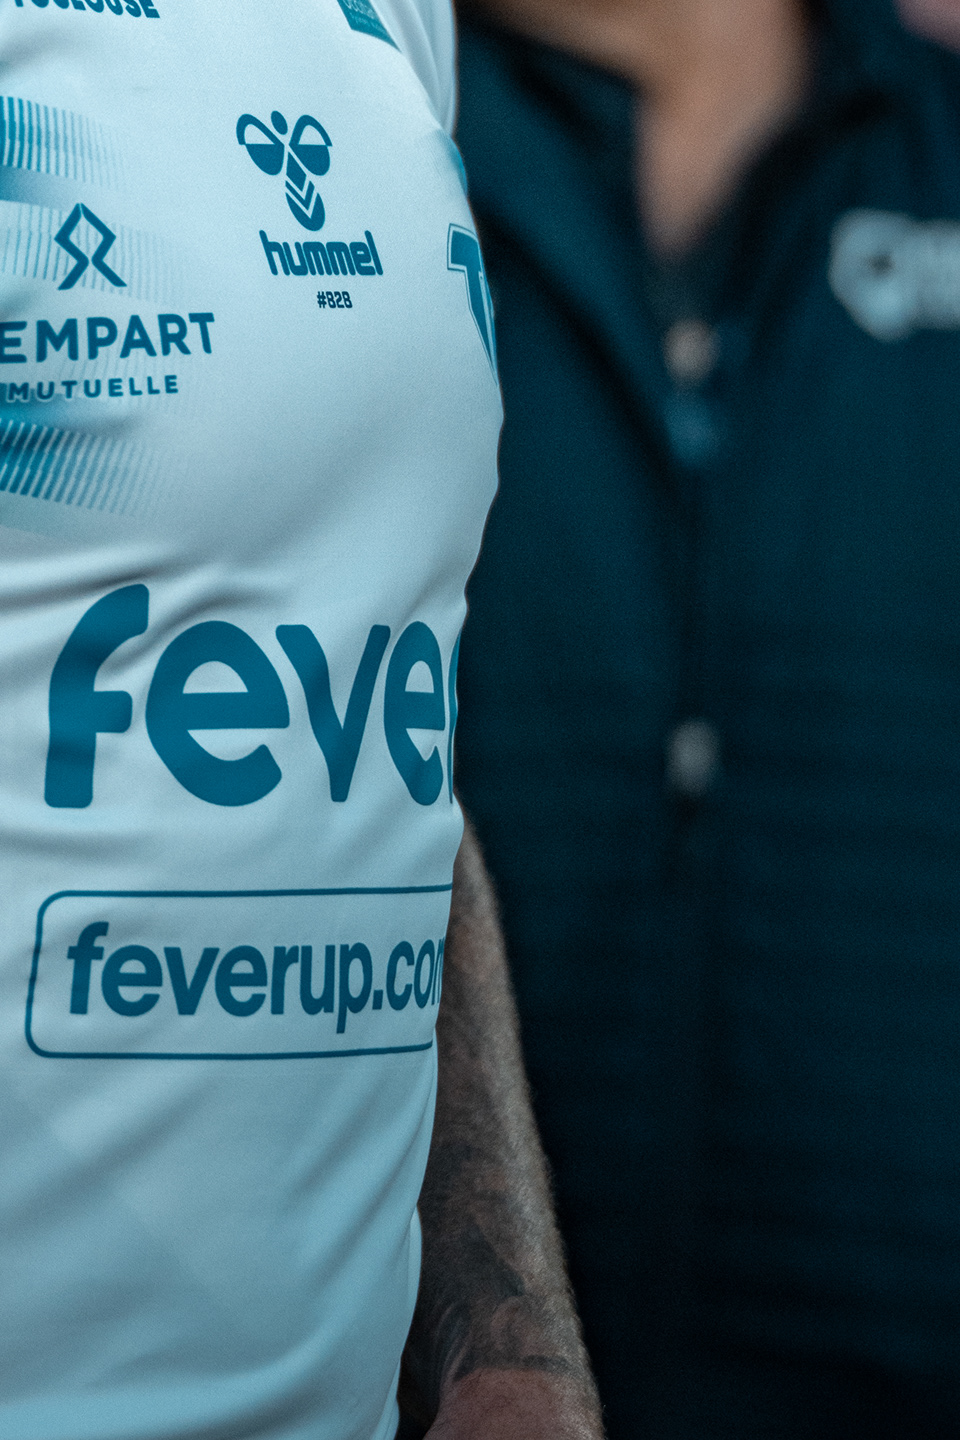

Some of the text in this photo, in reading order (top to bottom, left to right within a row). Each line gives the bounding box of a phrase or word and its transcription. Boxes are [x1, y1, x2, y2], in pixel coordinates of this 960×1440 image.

[258, 229, 384, 276] hummel
[6, 374, 179, 403] MUTUELLE
[44, 583, 459, 808] feve
